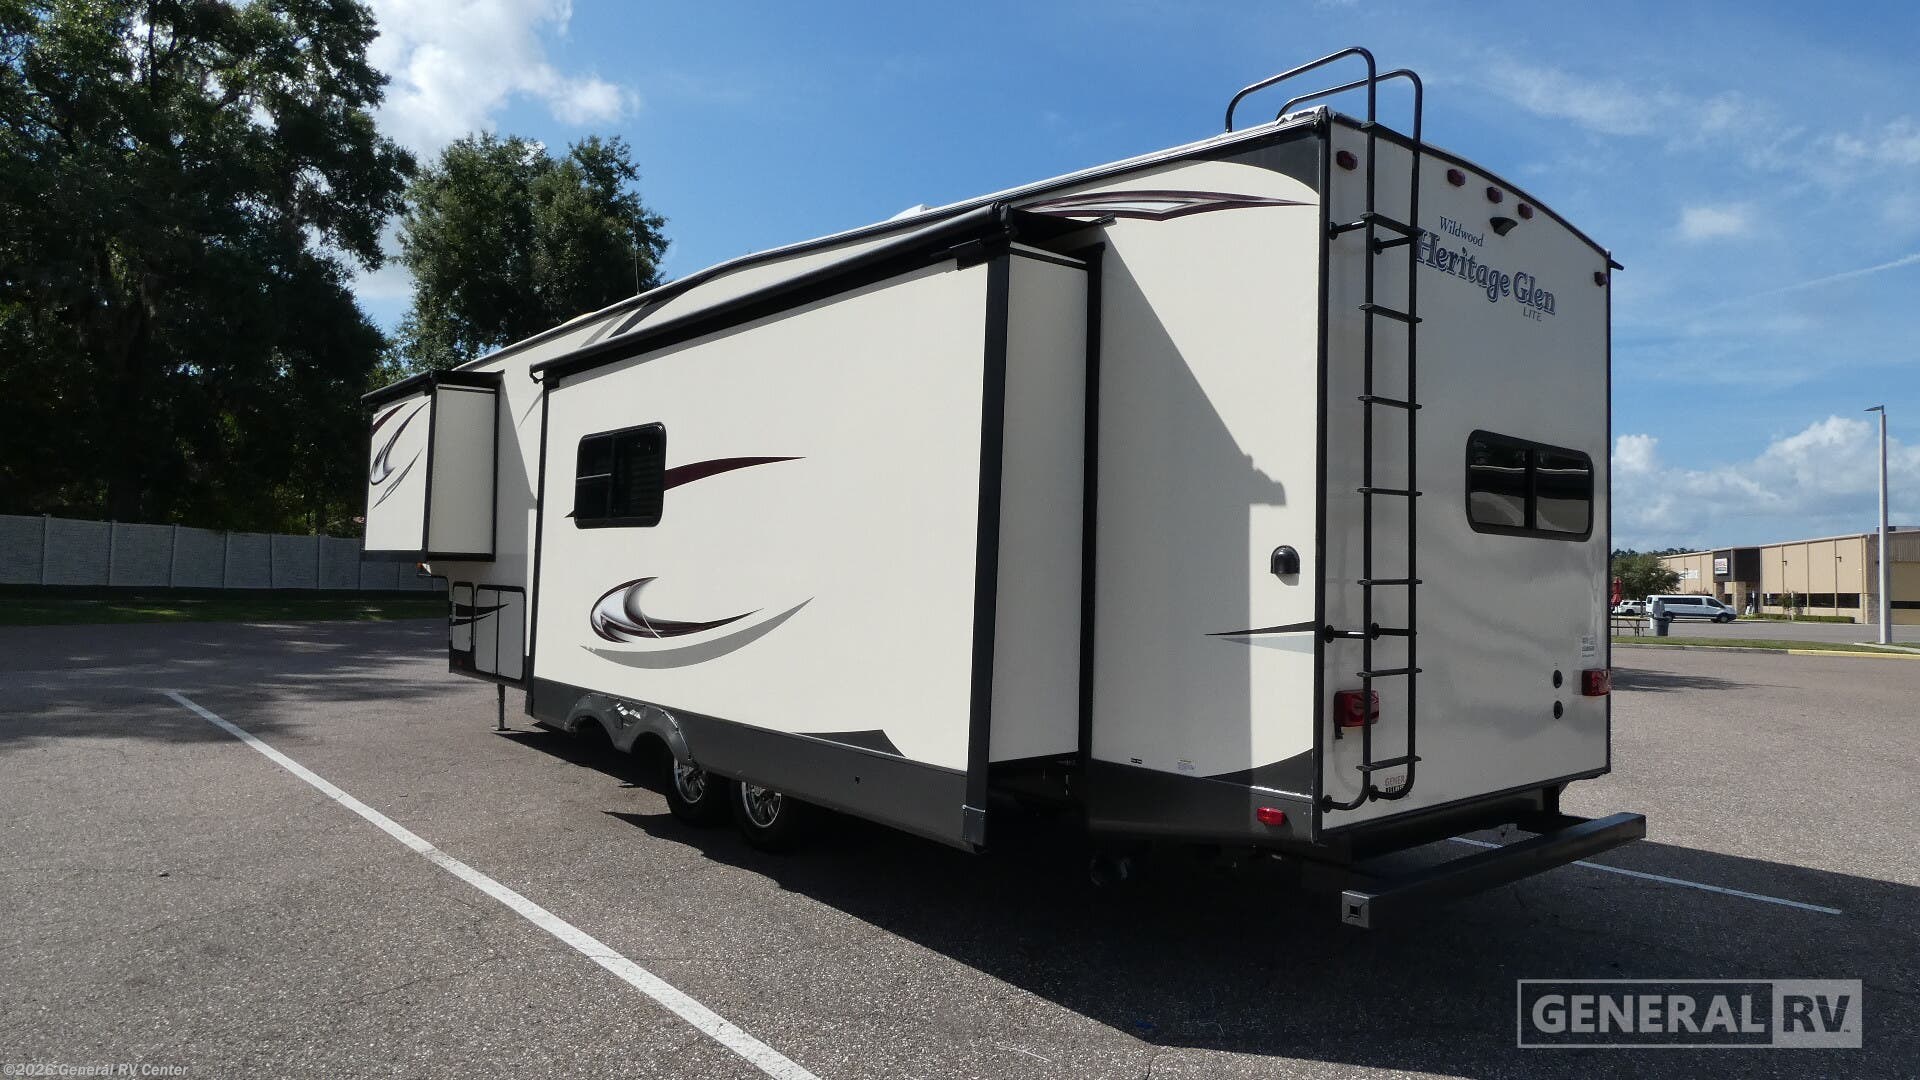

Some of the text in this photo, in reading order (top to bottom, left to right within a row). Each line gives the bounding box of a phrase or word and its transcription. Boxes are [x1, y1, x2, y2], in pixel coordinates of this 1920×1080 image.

[1440, 215, 1484, 247] Wildwood
[1416, 230, 1556, 316] Heritage Glen
[1523, 306, 1543, 322] LITE
